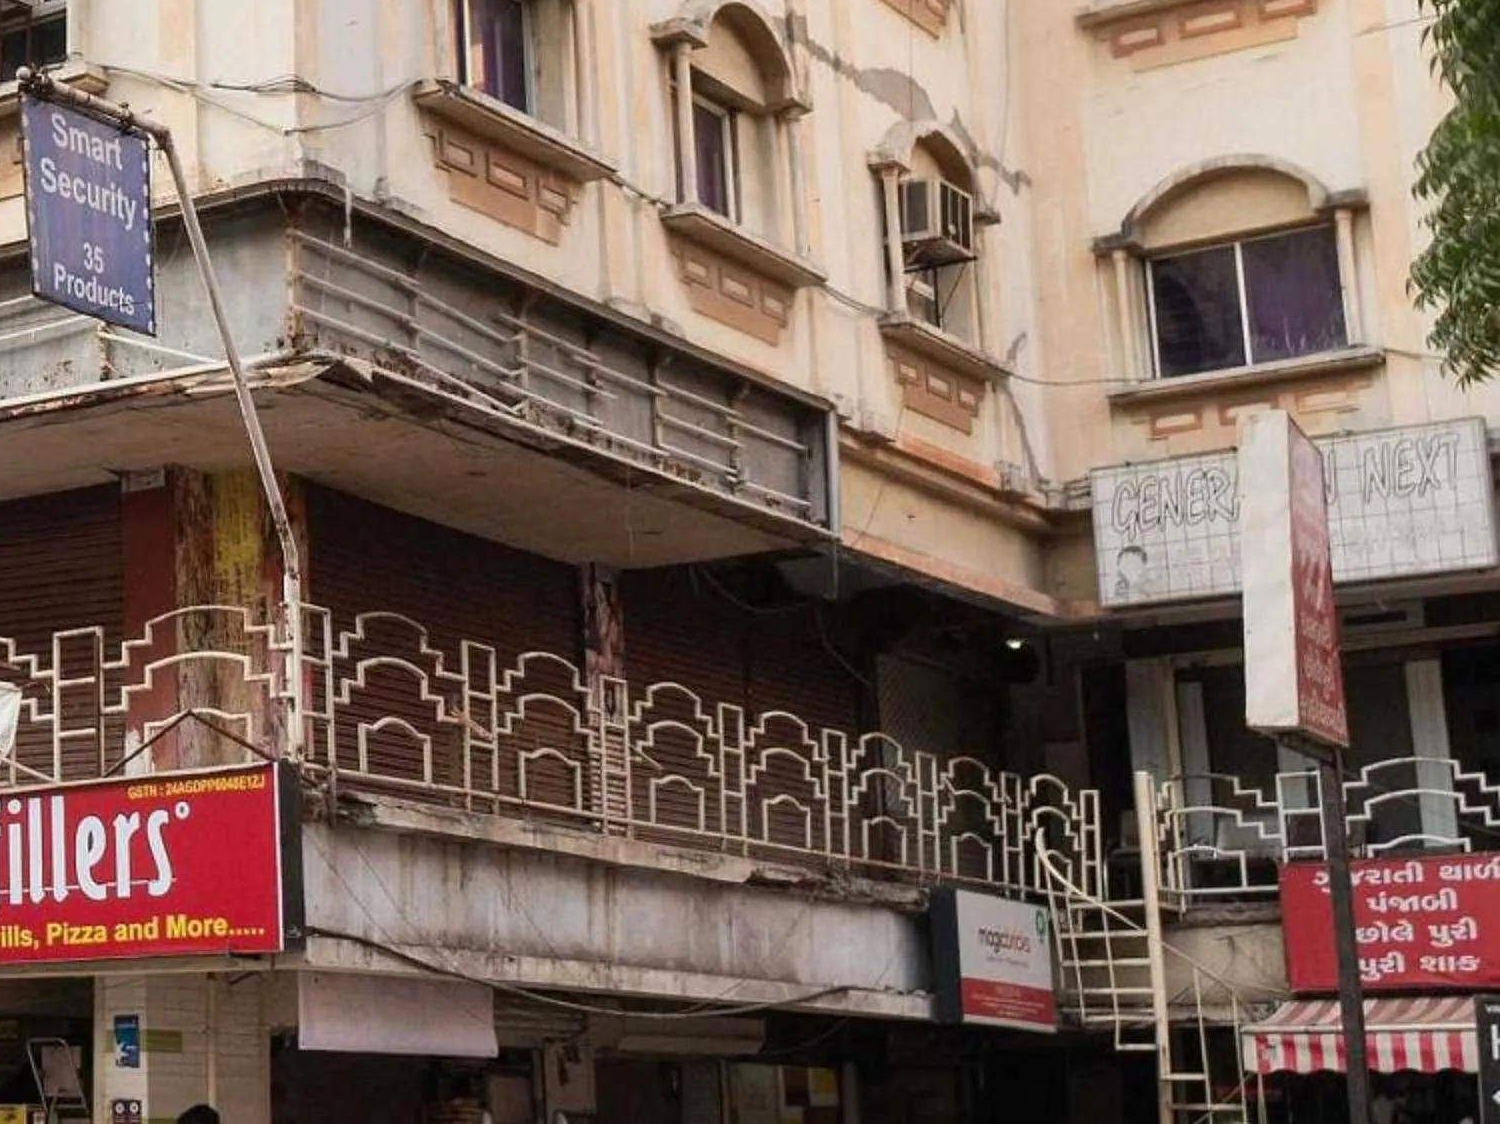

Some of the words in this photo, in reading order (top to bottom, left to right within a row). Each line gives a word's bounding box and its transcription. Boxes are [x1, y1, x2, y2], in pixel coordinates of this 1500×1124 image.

[51, 112, 123, 171] Smart
[40, 156, 137, 231] Security
[83, 242, 105, 275] 35
[53, 262, 135, 316] Products
[1362, 431, 1461, 506] NEXT
[46, 920, 107, 947] Pizza
[113, 917, 159, 941] and
[1428, 915, 1478, 949] પુરી
[1419, 954, 1481, 973] શાક
